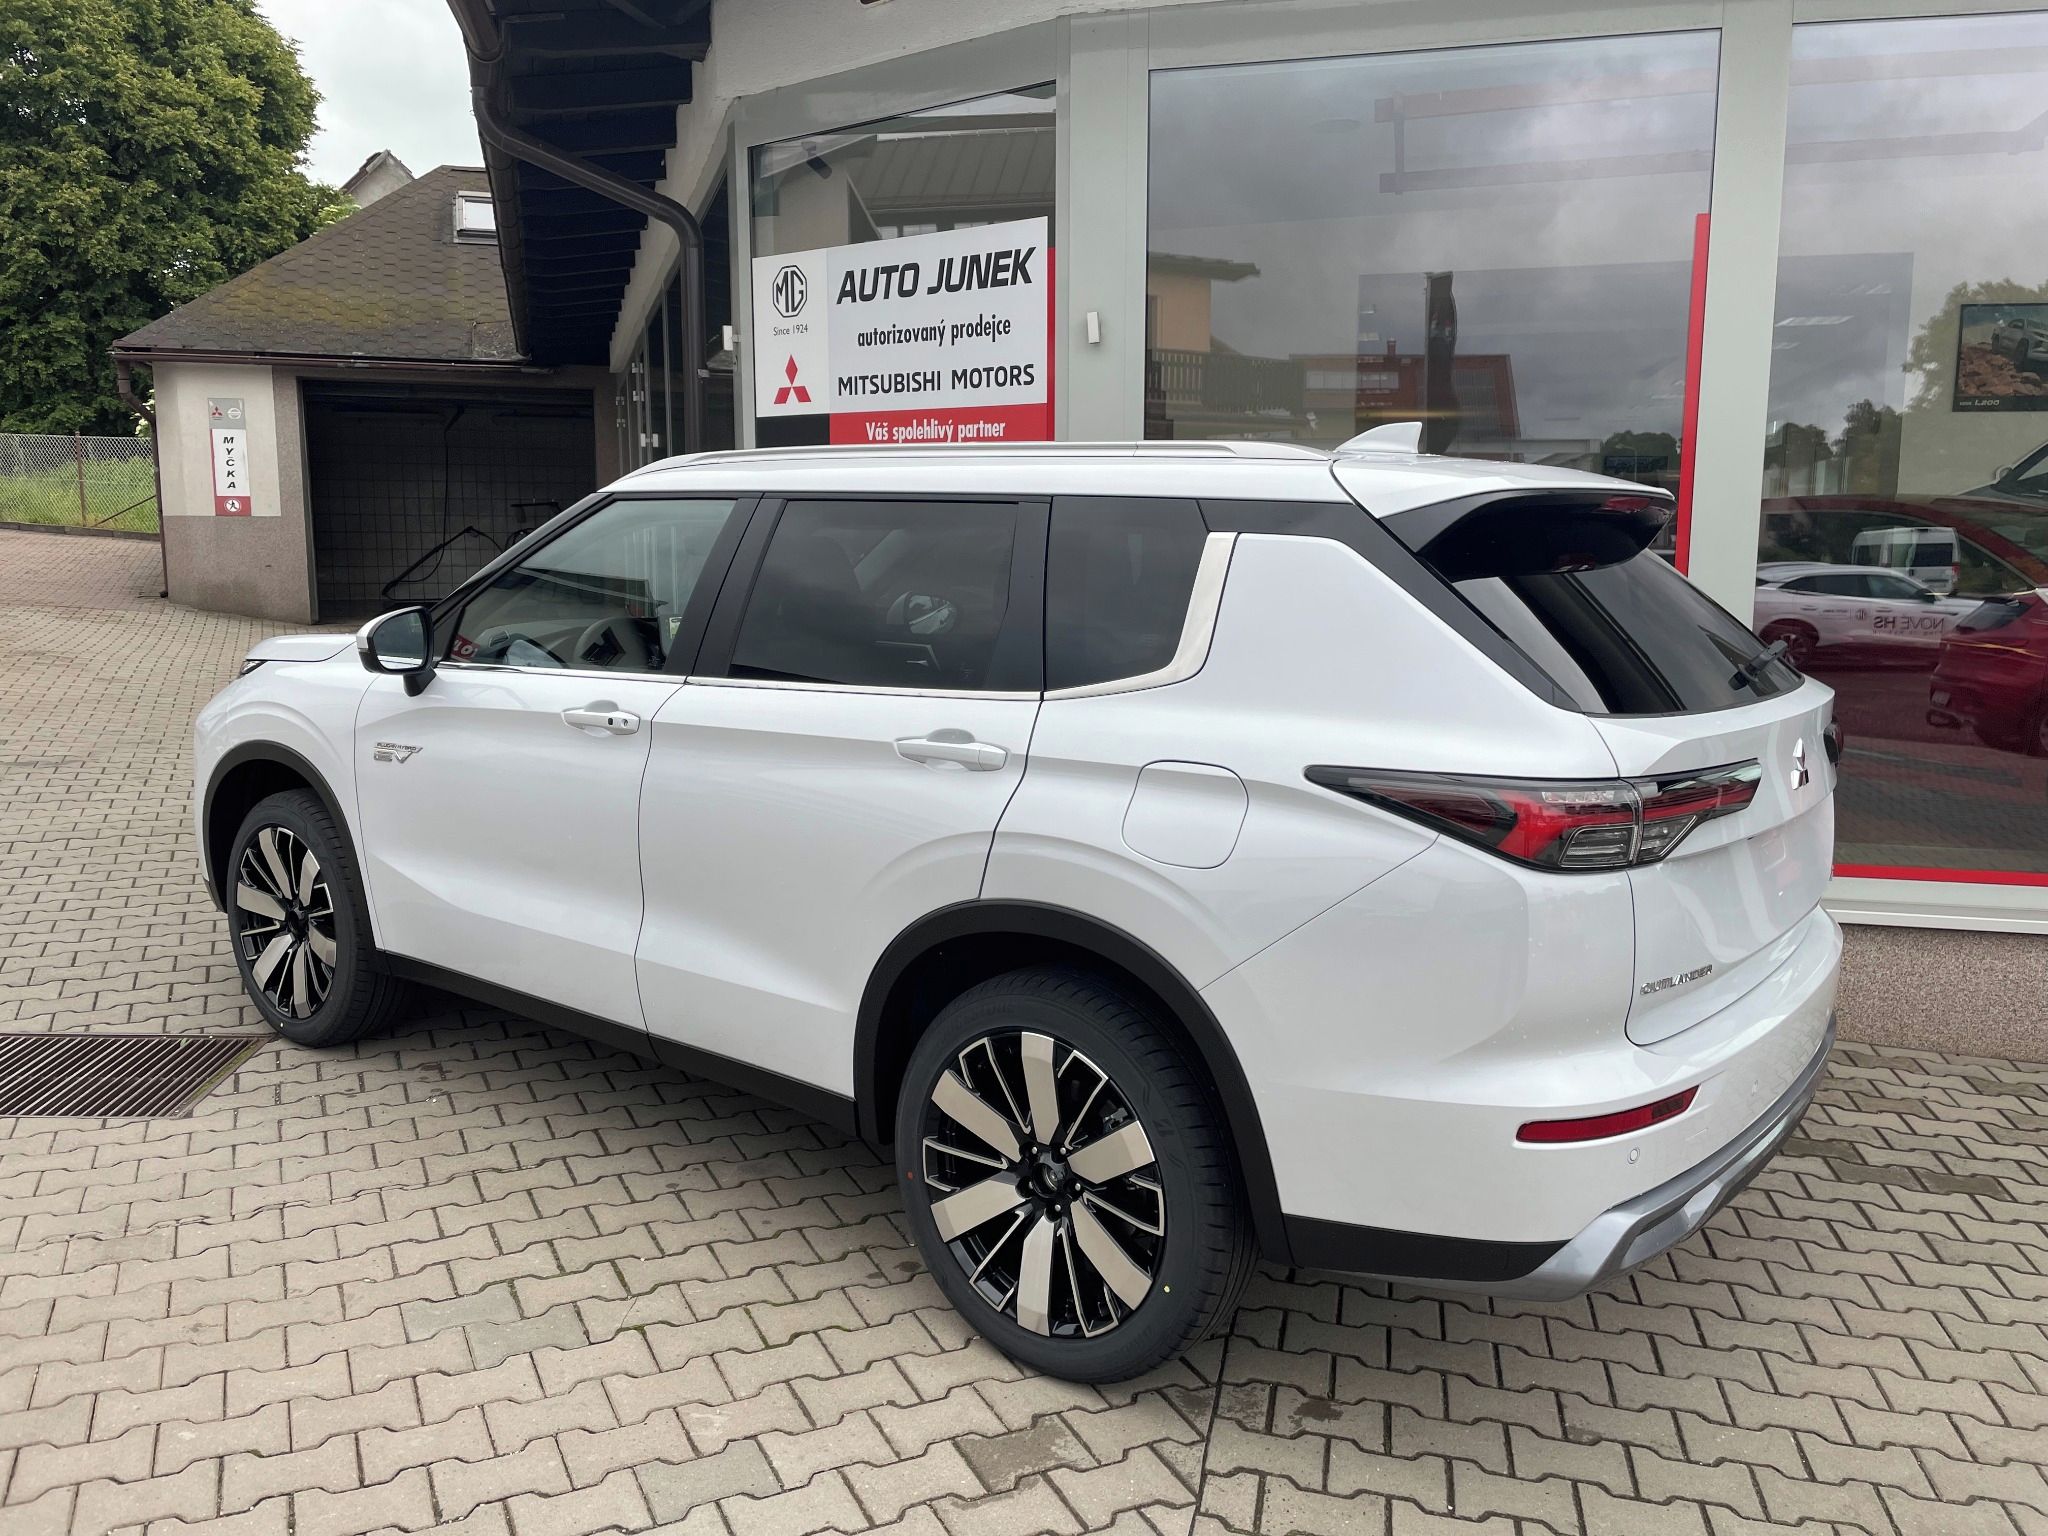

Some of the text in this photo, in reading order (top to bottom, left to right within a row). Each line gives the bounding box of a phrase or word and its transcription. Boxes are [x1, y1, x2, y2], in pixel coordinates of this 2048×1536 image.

[775, 270, 804, 313] MG
[836, 246, 1036, 304] AUTO JUNEK
[773, 324, 808, 336] Since 1924
[857, 313, 1011, 347] autorizovaný prodejce
[838, 363, 1035, 396] MITSUBISHI MOTORS
[865, 418, 1006, 443] Váš spolehlivý partner
[1640, 964, 1712, 995] OUTLANDER
